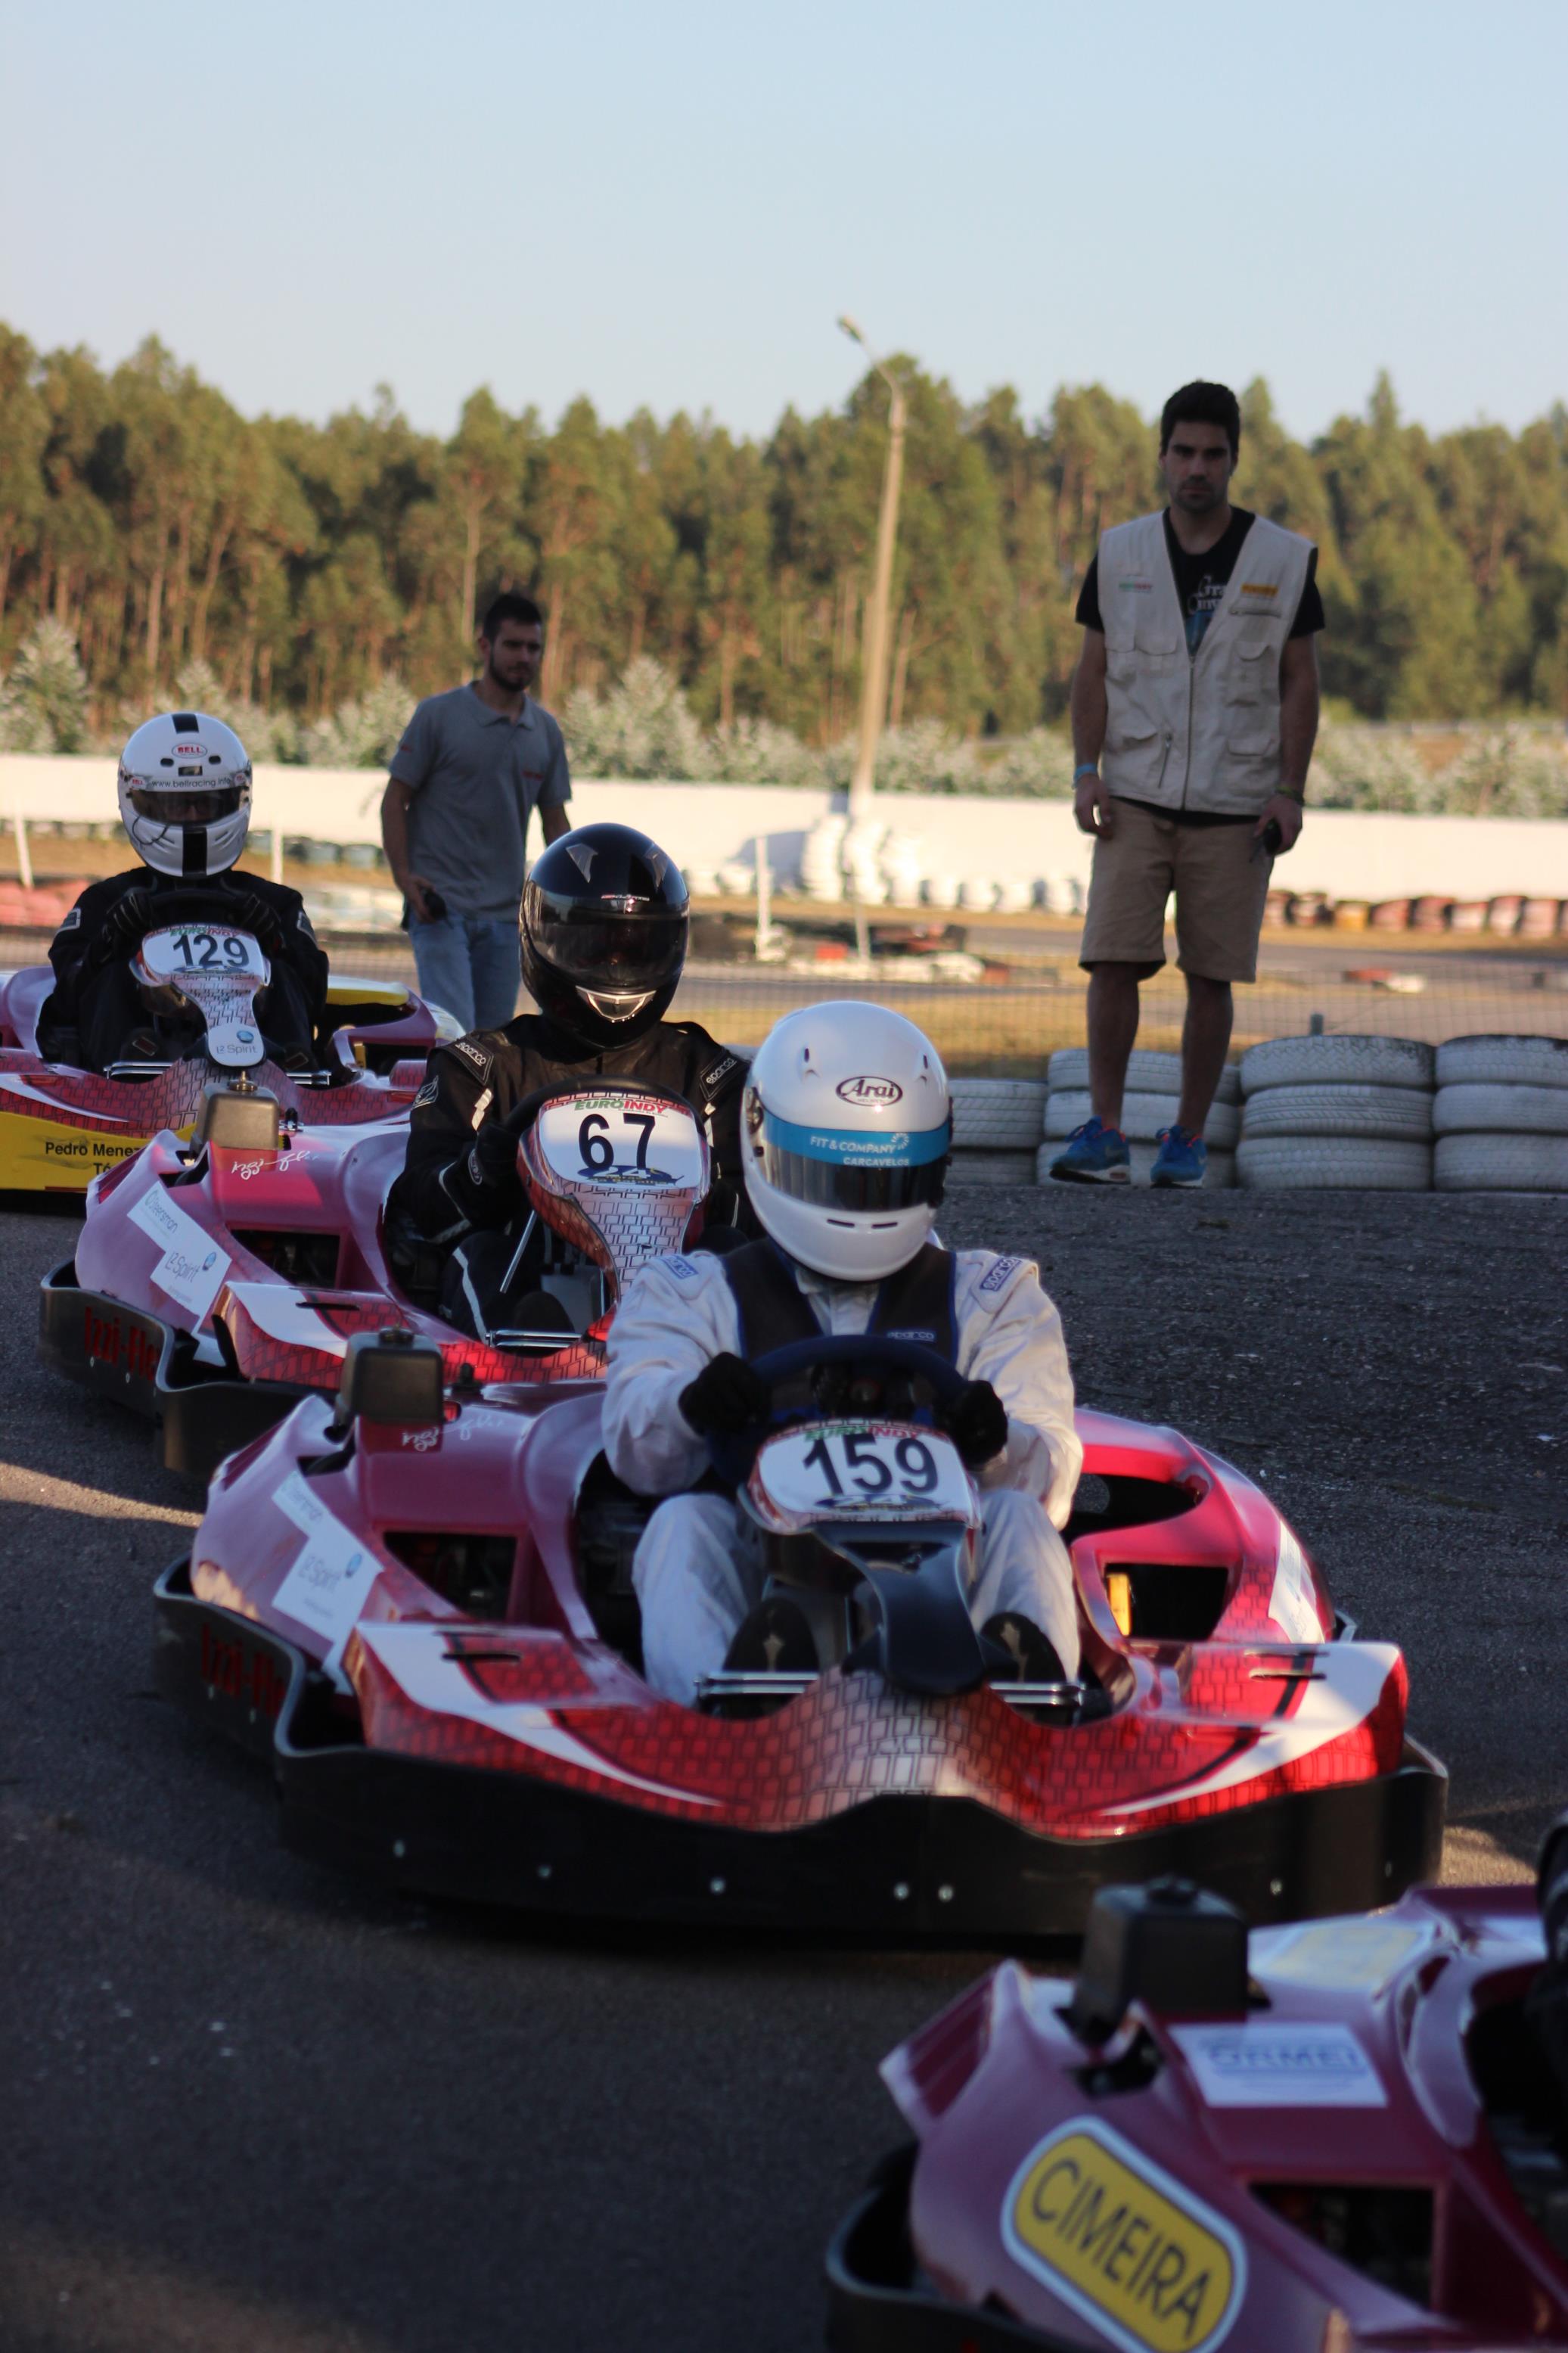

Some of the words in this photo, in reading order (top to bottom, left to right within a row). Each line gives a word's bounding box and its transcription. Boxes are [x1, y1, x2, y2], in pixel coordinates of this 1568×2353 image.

[172, 934, 250, 969] 129
[226, 1044, 258, 1055] Spirit
[455, 1042, 486, 1067] sparco
[841, 1079, 896, 1098] Arai
[574, 1099, 669, 1114] EUROINDY
[45, 1142, 88, 1156] Pedro
[579, 1113, 656, 1170] 67
[810, 1136, 828, 1149] FIT
[829, 1139, 837, 1151] &
[839, 1141, 899, 1155] COMPANY
[843, 1156, 910, 1167] CARCAVELOS
[173, 1256, 200, 1283] Spirit
[802, 1433, 939, 1497] 159
[1032, 2159, 1210, 2342] CIMEIRA
